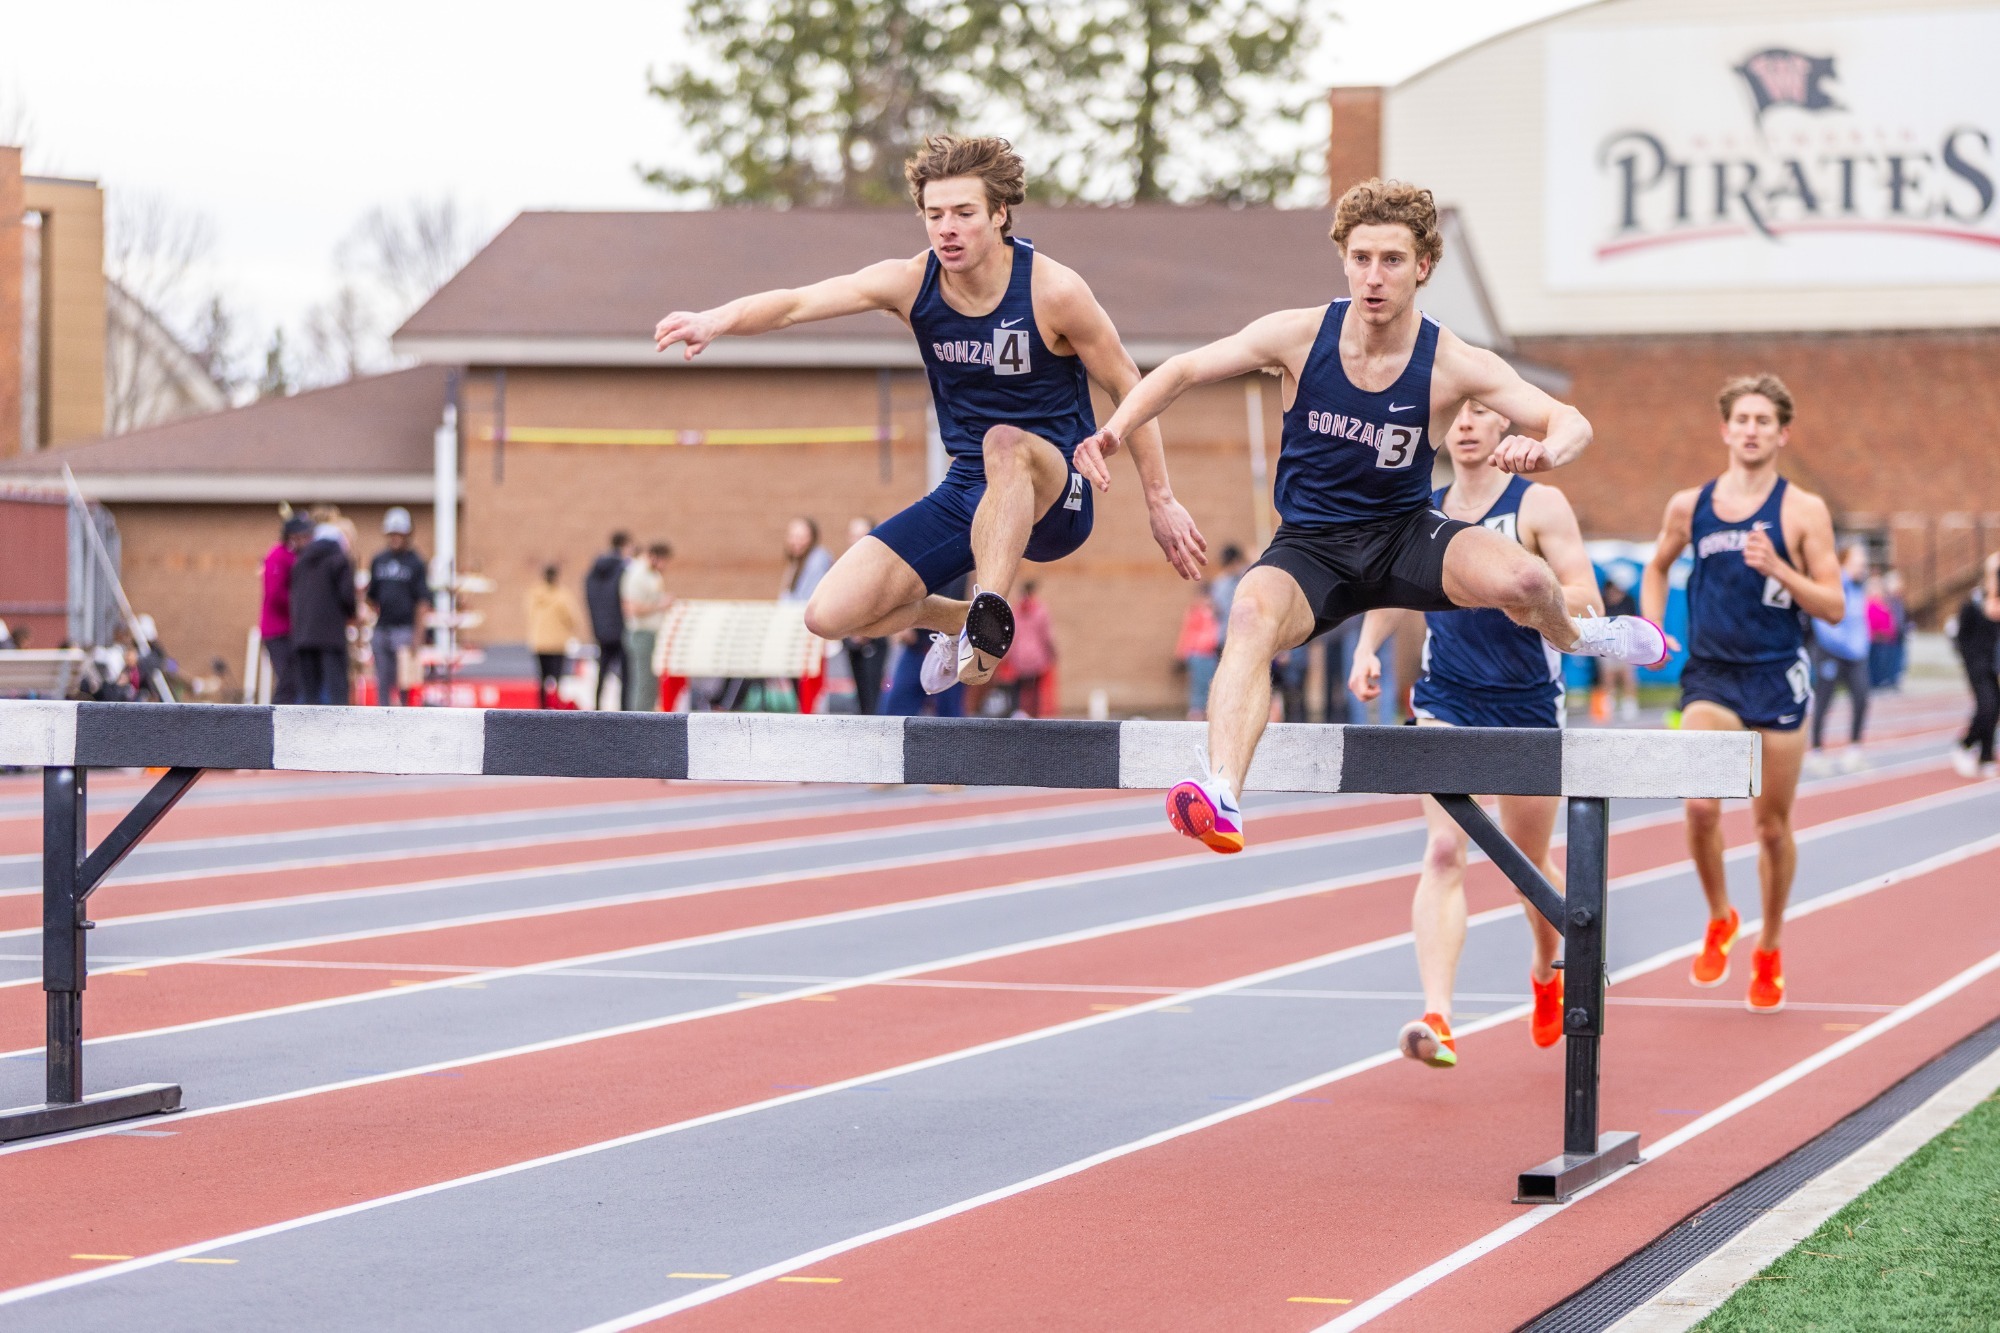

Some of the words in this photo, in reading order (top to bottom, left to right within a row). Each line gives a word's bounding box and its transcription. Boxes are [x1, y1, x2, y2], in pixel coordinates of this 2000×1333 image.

[1599, 126, 1996, 241] PIRATES
[999, 333, 1024, 373] 4
[1384, 428, 1412, 467] 3
